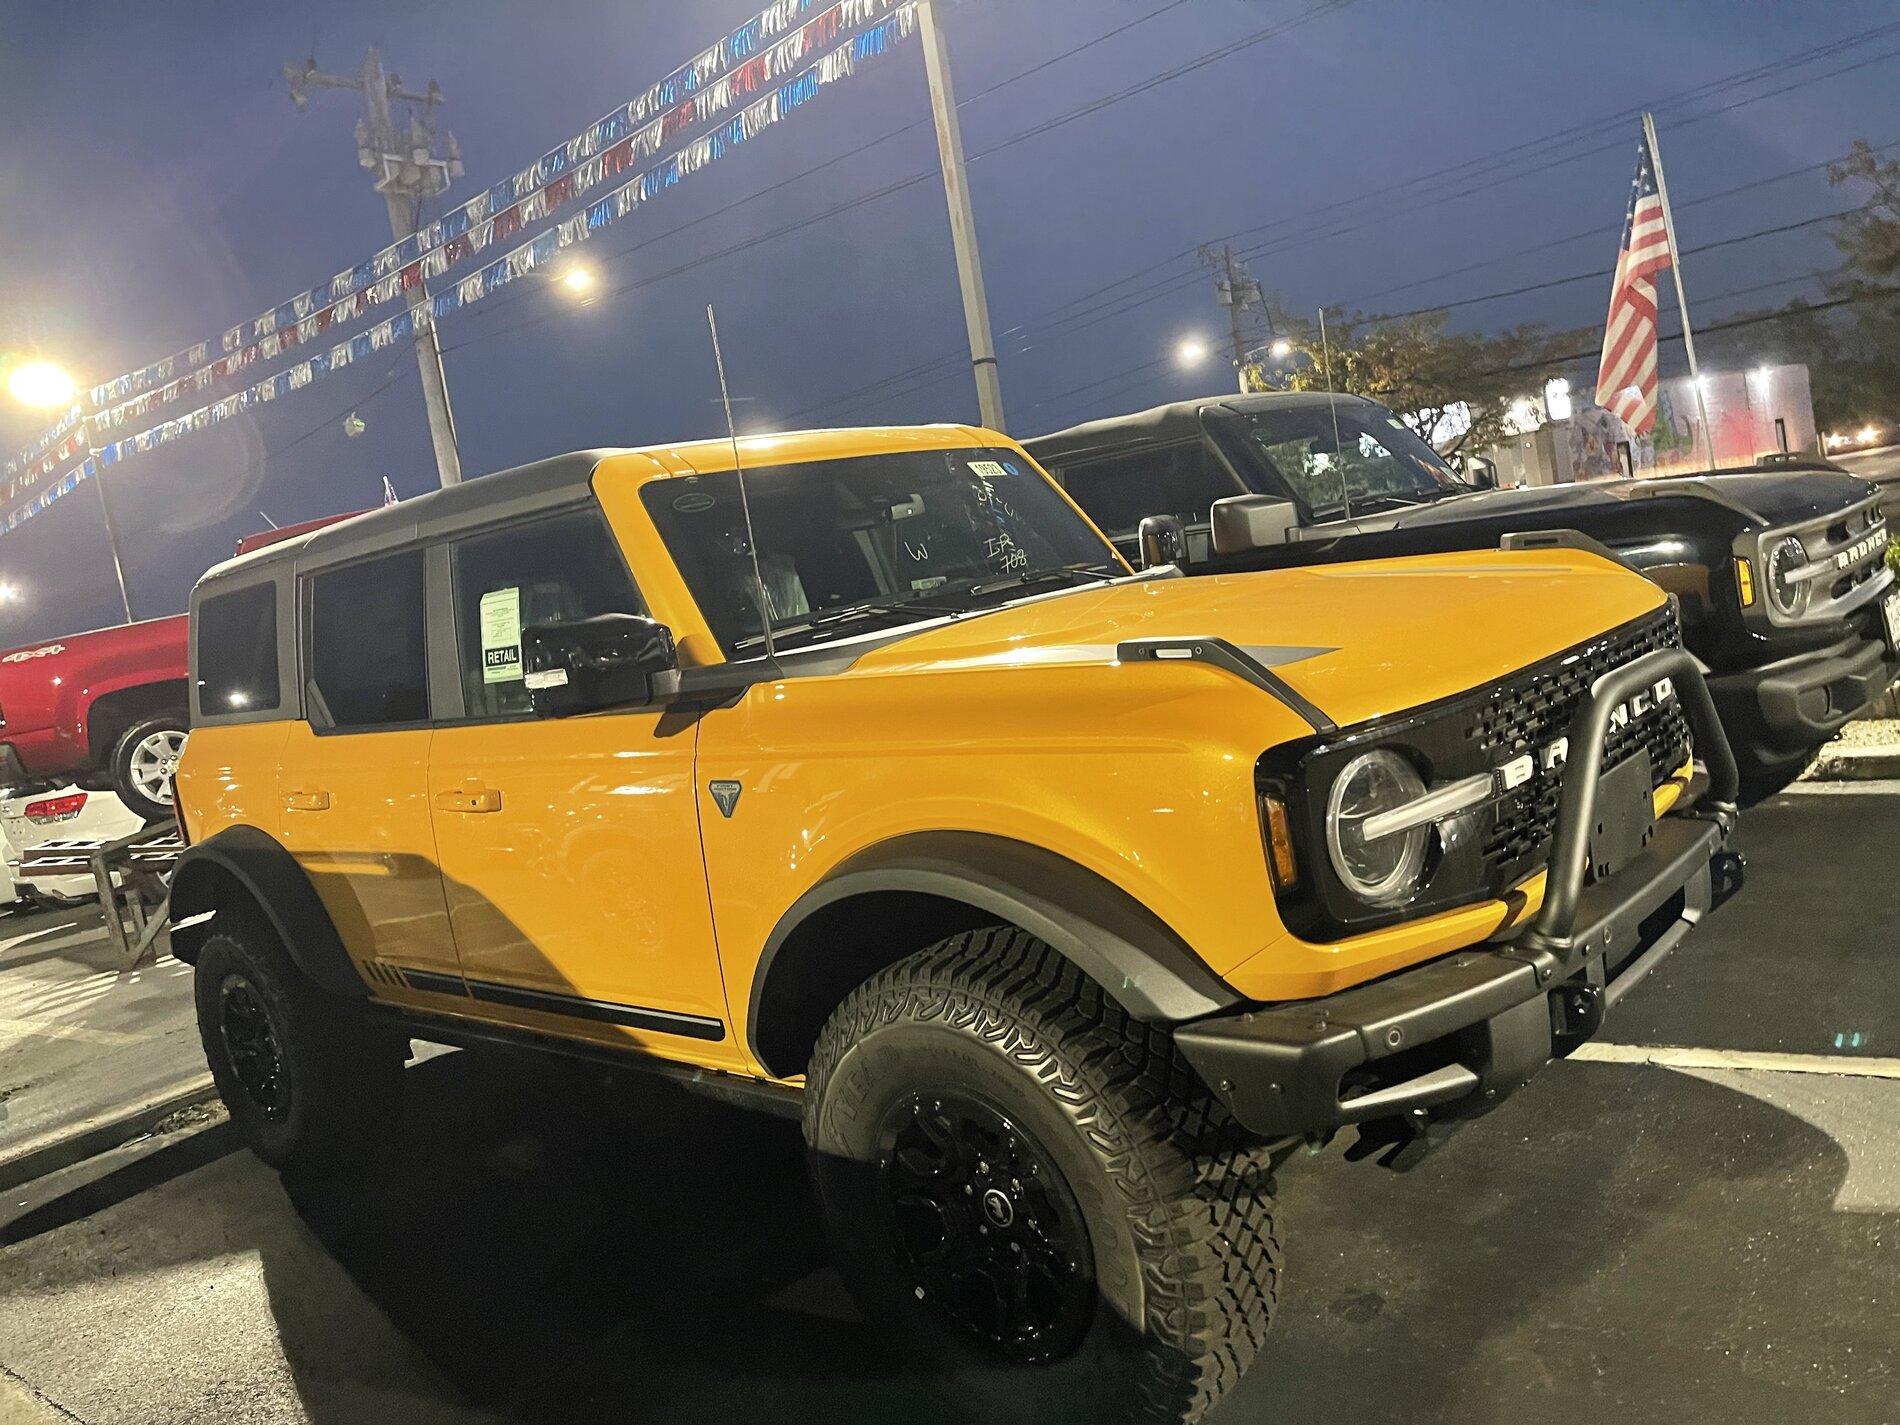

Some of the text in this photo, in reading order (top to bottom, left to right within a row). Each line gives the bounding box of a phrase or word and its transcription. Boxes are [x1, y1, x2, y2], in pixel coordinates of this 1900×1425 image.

[1837, 528, 1887, 569] BRONCO
[487, 648, 517, 664] RETAIL
[1499, 677, 1674, 791] BRNCO
